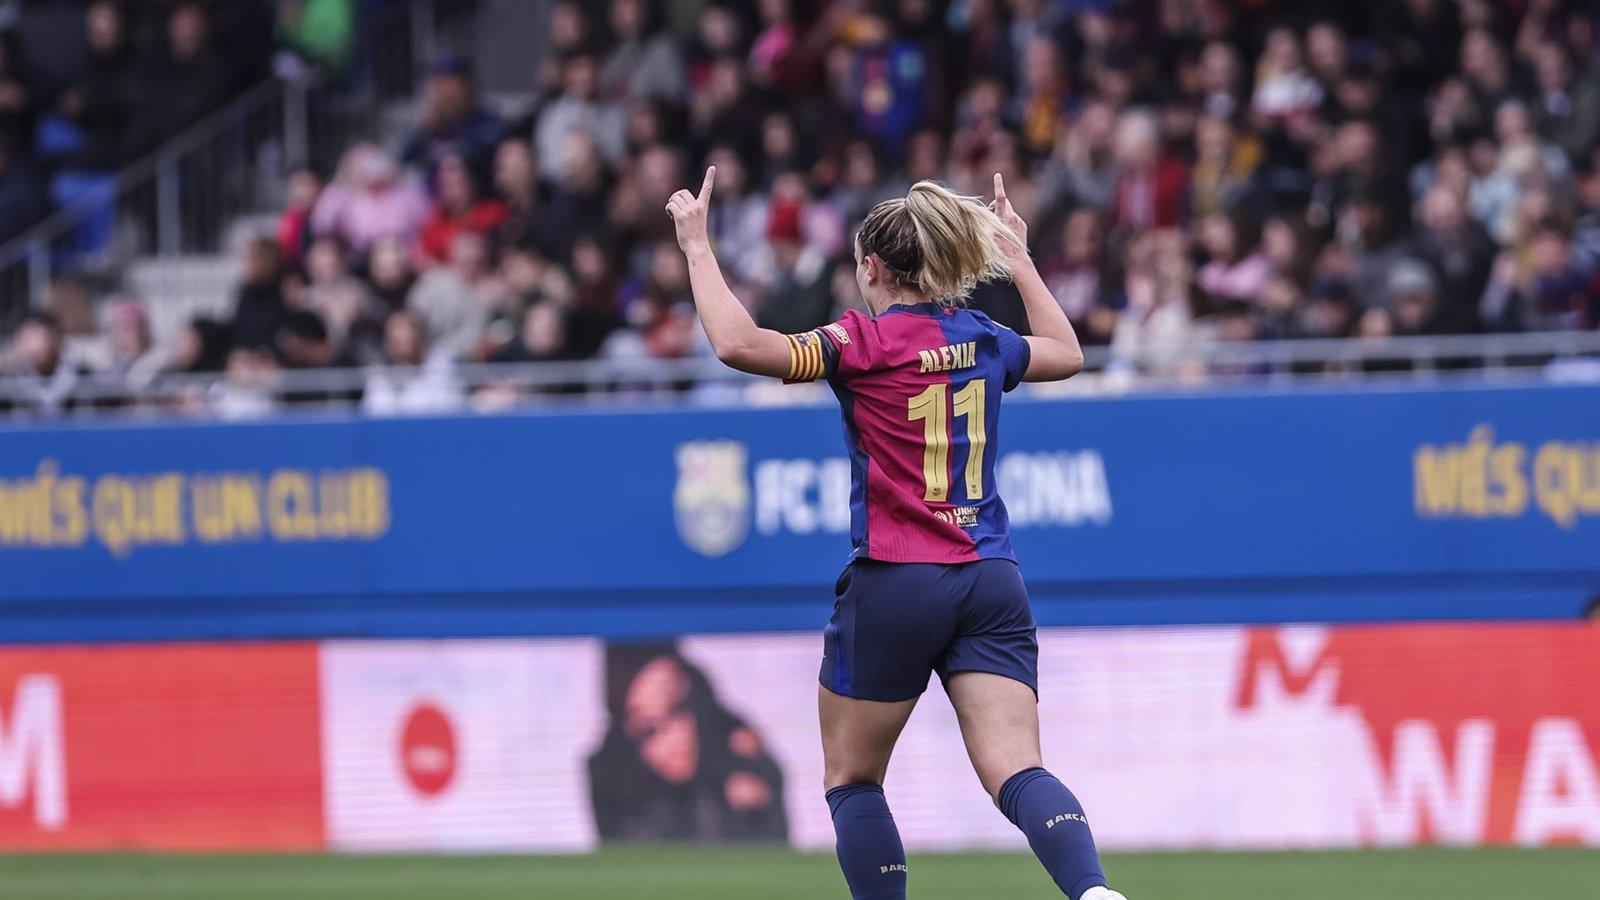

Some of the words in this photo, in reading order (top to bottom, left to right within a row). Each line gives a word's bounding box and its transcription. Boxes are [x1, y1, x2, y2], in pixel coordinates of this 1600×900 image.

[918, 341, 976, 373] ALEXIA
[908, 379, 985, 502] 11
[1414, 425, 1527, 518] MÉS
[95, 474, 184, 559] QUE
[193, 473, 262, 543] UN
[269, 467, 390, 540] CLUB
